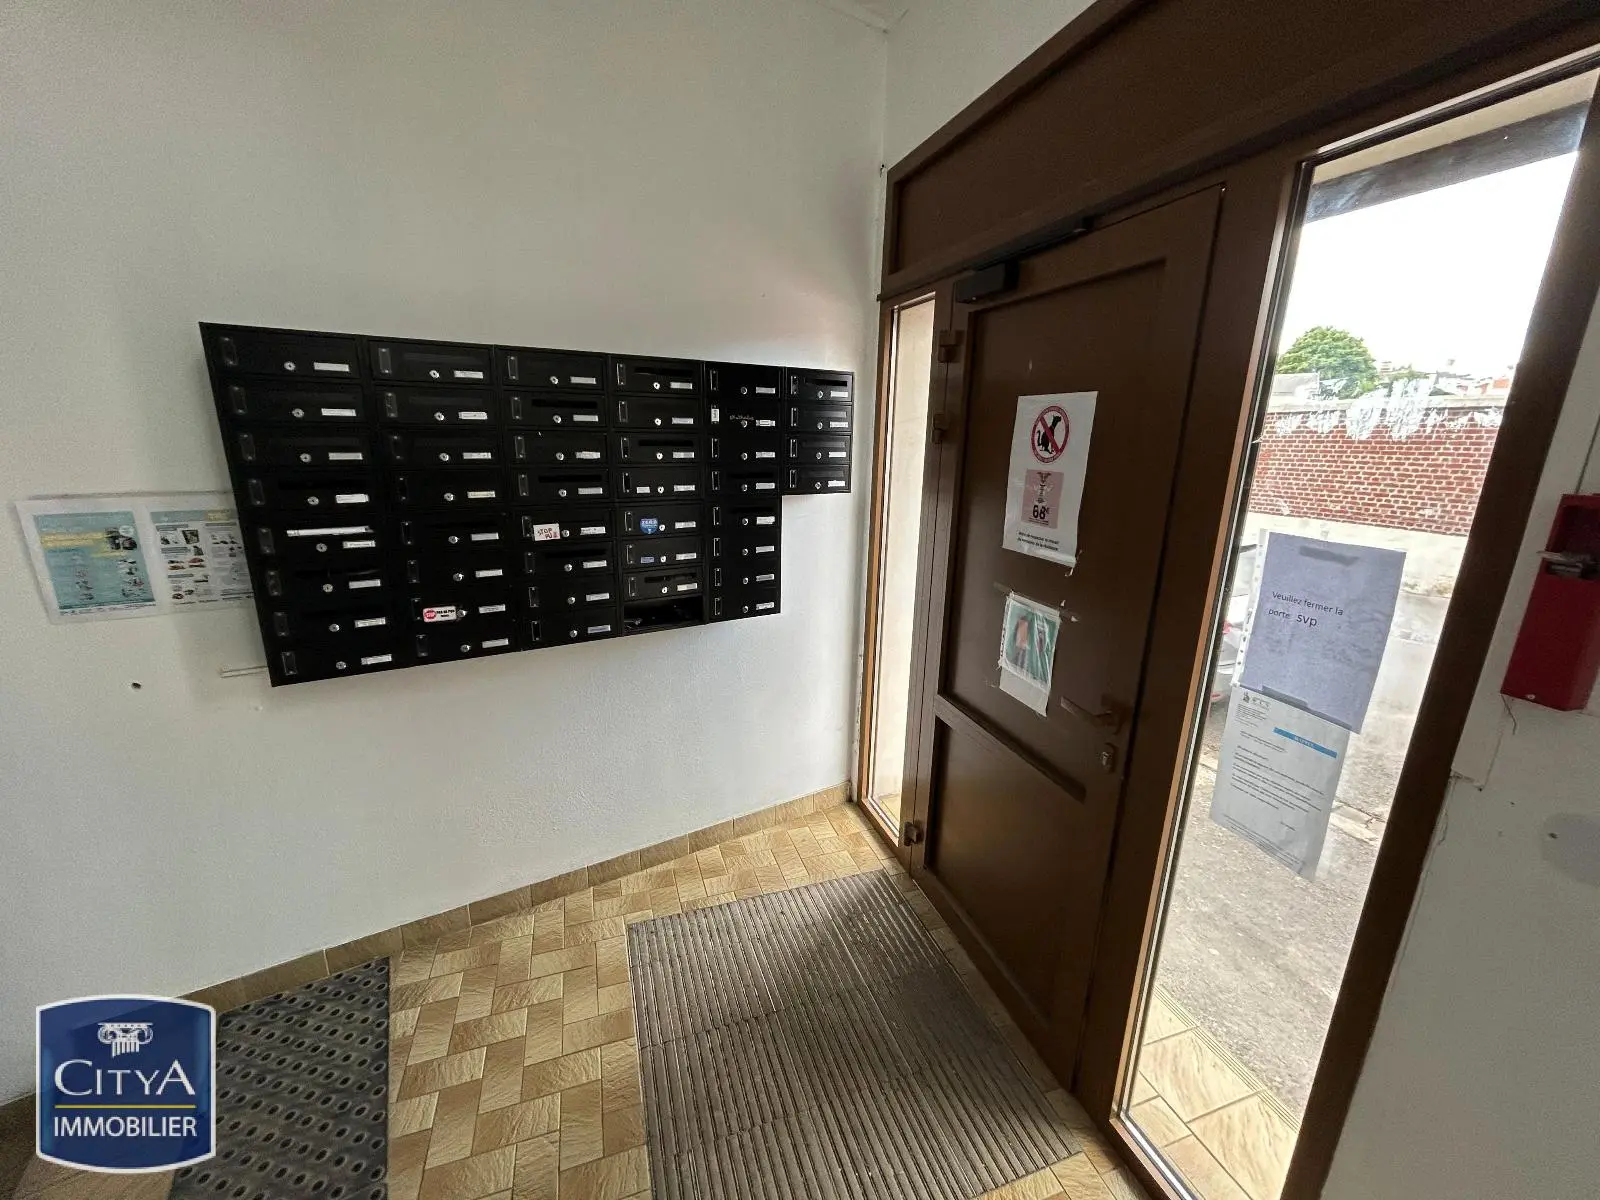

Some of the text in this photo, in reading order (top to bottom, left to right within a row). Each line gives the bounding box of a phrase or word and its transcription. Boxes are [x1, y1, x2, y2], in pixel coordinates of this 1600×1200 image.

[537, 527, 553, 536] STOP
[1272, 591, 1344, 616] Veuillez fermer la
[1268, 608, 1318, 628] porte svp
